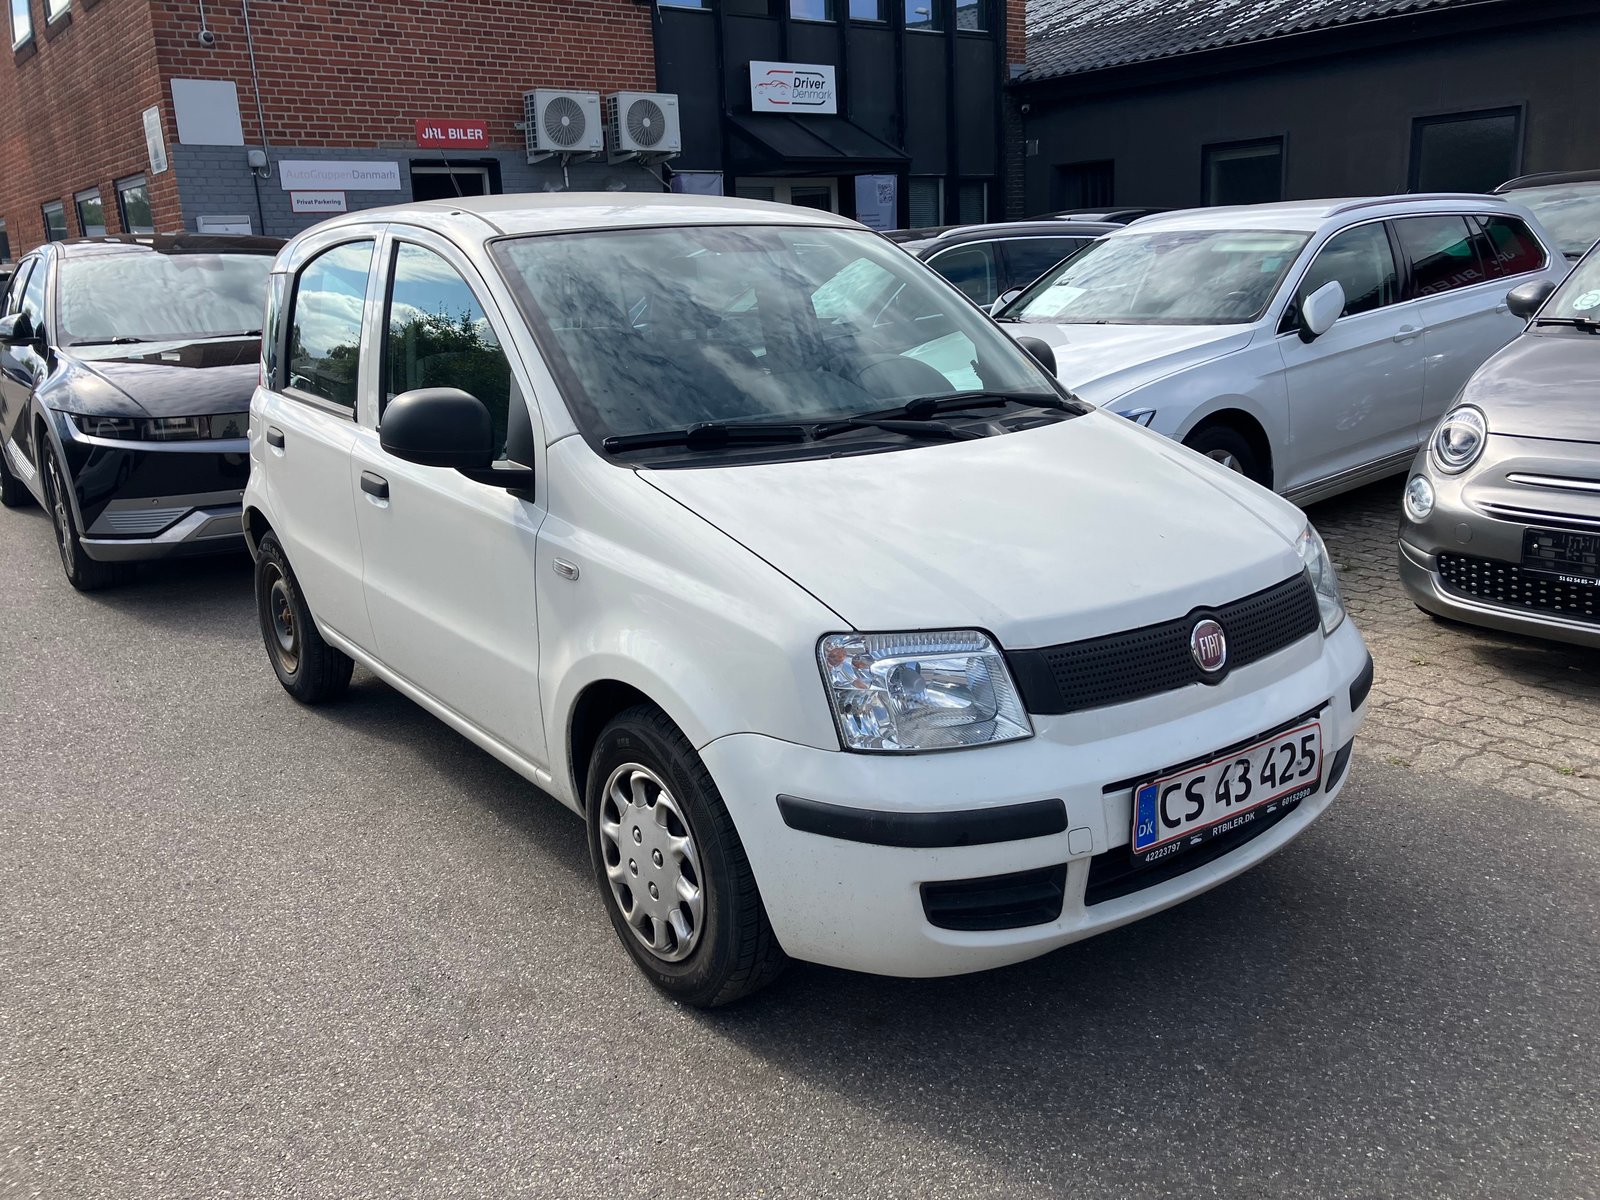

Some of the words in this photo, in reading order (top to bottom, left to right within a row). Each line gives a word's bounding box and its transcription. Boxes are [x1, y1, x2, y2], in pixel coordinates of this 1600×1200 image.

[793, 77, 826, 89] Driver
[792, 89, 832, 100] Denmark
[422, 128, 446, 139] JRL
[448, 128, 484, 140] BILER
[1199, 633, 1220, 660] FIAT
[1160, 775, 1206, 829] CS
[1215, 758, 1253, 807] 43
[1260, 734, 1316, 789] 425
[1138, 821, 1153, 838] DK
[1145, 841, 1181, 862] 42223797
[1212, 811, 1256, 836] RTBILER.DK
